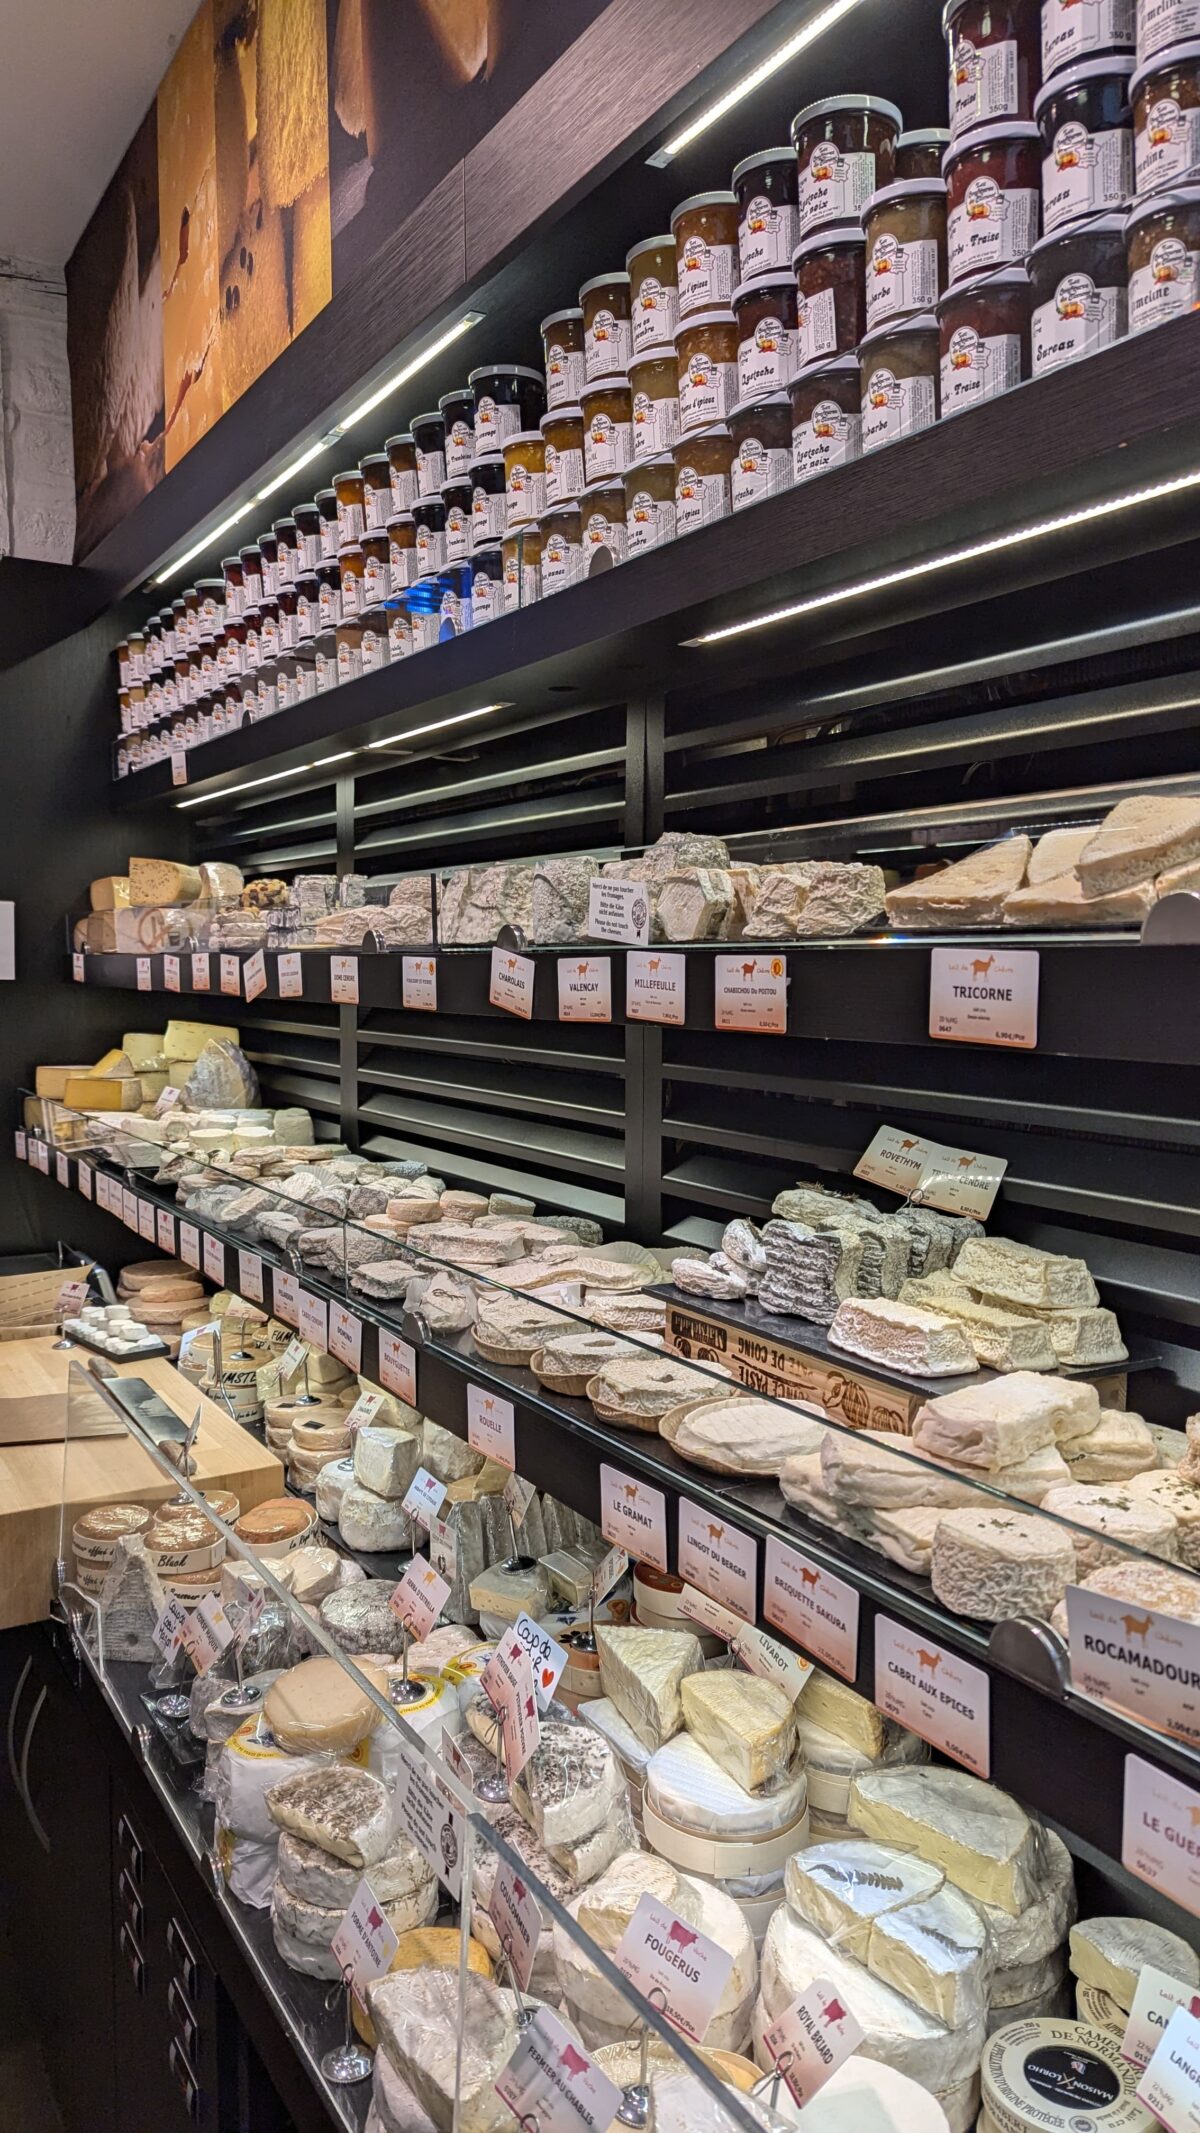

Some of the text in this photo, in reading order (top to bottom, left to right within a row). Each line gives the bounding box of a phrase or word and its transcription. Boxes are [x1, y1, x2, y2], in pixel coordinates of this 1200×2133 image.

[1036, 337, 1076, 362] Sureau
[953, 379, 980, 396] Fraise
[498, 972, 526, 990] CHAROLAIS
[569, 983, 599, 992] VALENCAY
[723, 986, 750, 995] CHABICHOU
[758, 987, 777, 996] POITOU
[953, 985, 1013, 1002] TRICORNE
[880, 1149, 922, 1171] ROVETHYM
[337, 1326, 353, 1344] DOMINO
[738, 1336, 785, 1372] DE COING
[479, 1414, 502, 1434] ROUELLE
[613, 1499, 652, 1530] LE GRAMAT
[686, 1535, 747, 1580] LINGOT DU BERGER
[406, 1578, 418, 1595] SERRA
[774, 1576, 815, 1611] BRIQUETTE
[815, 1602, 847, 1633] SAKURA
[517, 1618, 540, 1650] Coup
[759, 1634, 789, 1672] LIVAROT
[1084, 1634, 1200, 1689] ROCAMADOUR
[887, 1660, 975, 1721] CABRI AUX EPICES
[1142, 1810, 1161, 1833] LE
[644, 1933, 701, 1984] FOUGERUS
[796, 2005, 834, 2065] ROYAL BRIARD
[1027, 2064, 1063, 2082] LORHO
[1051, 2030, 1074, 2041] DE
[1077, 2036, 1137, 2098] NORMANDIE
[527, 2045, 595, 2126] FERMIER AU CHABLIS
[1073, 2080, 1114, 2101] MAISON
